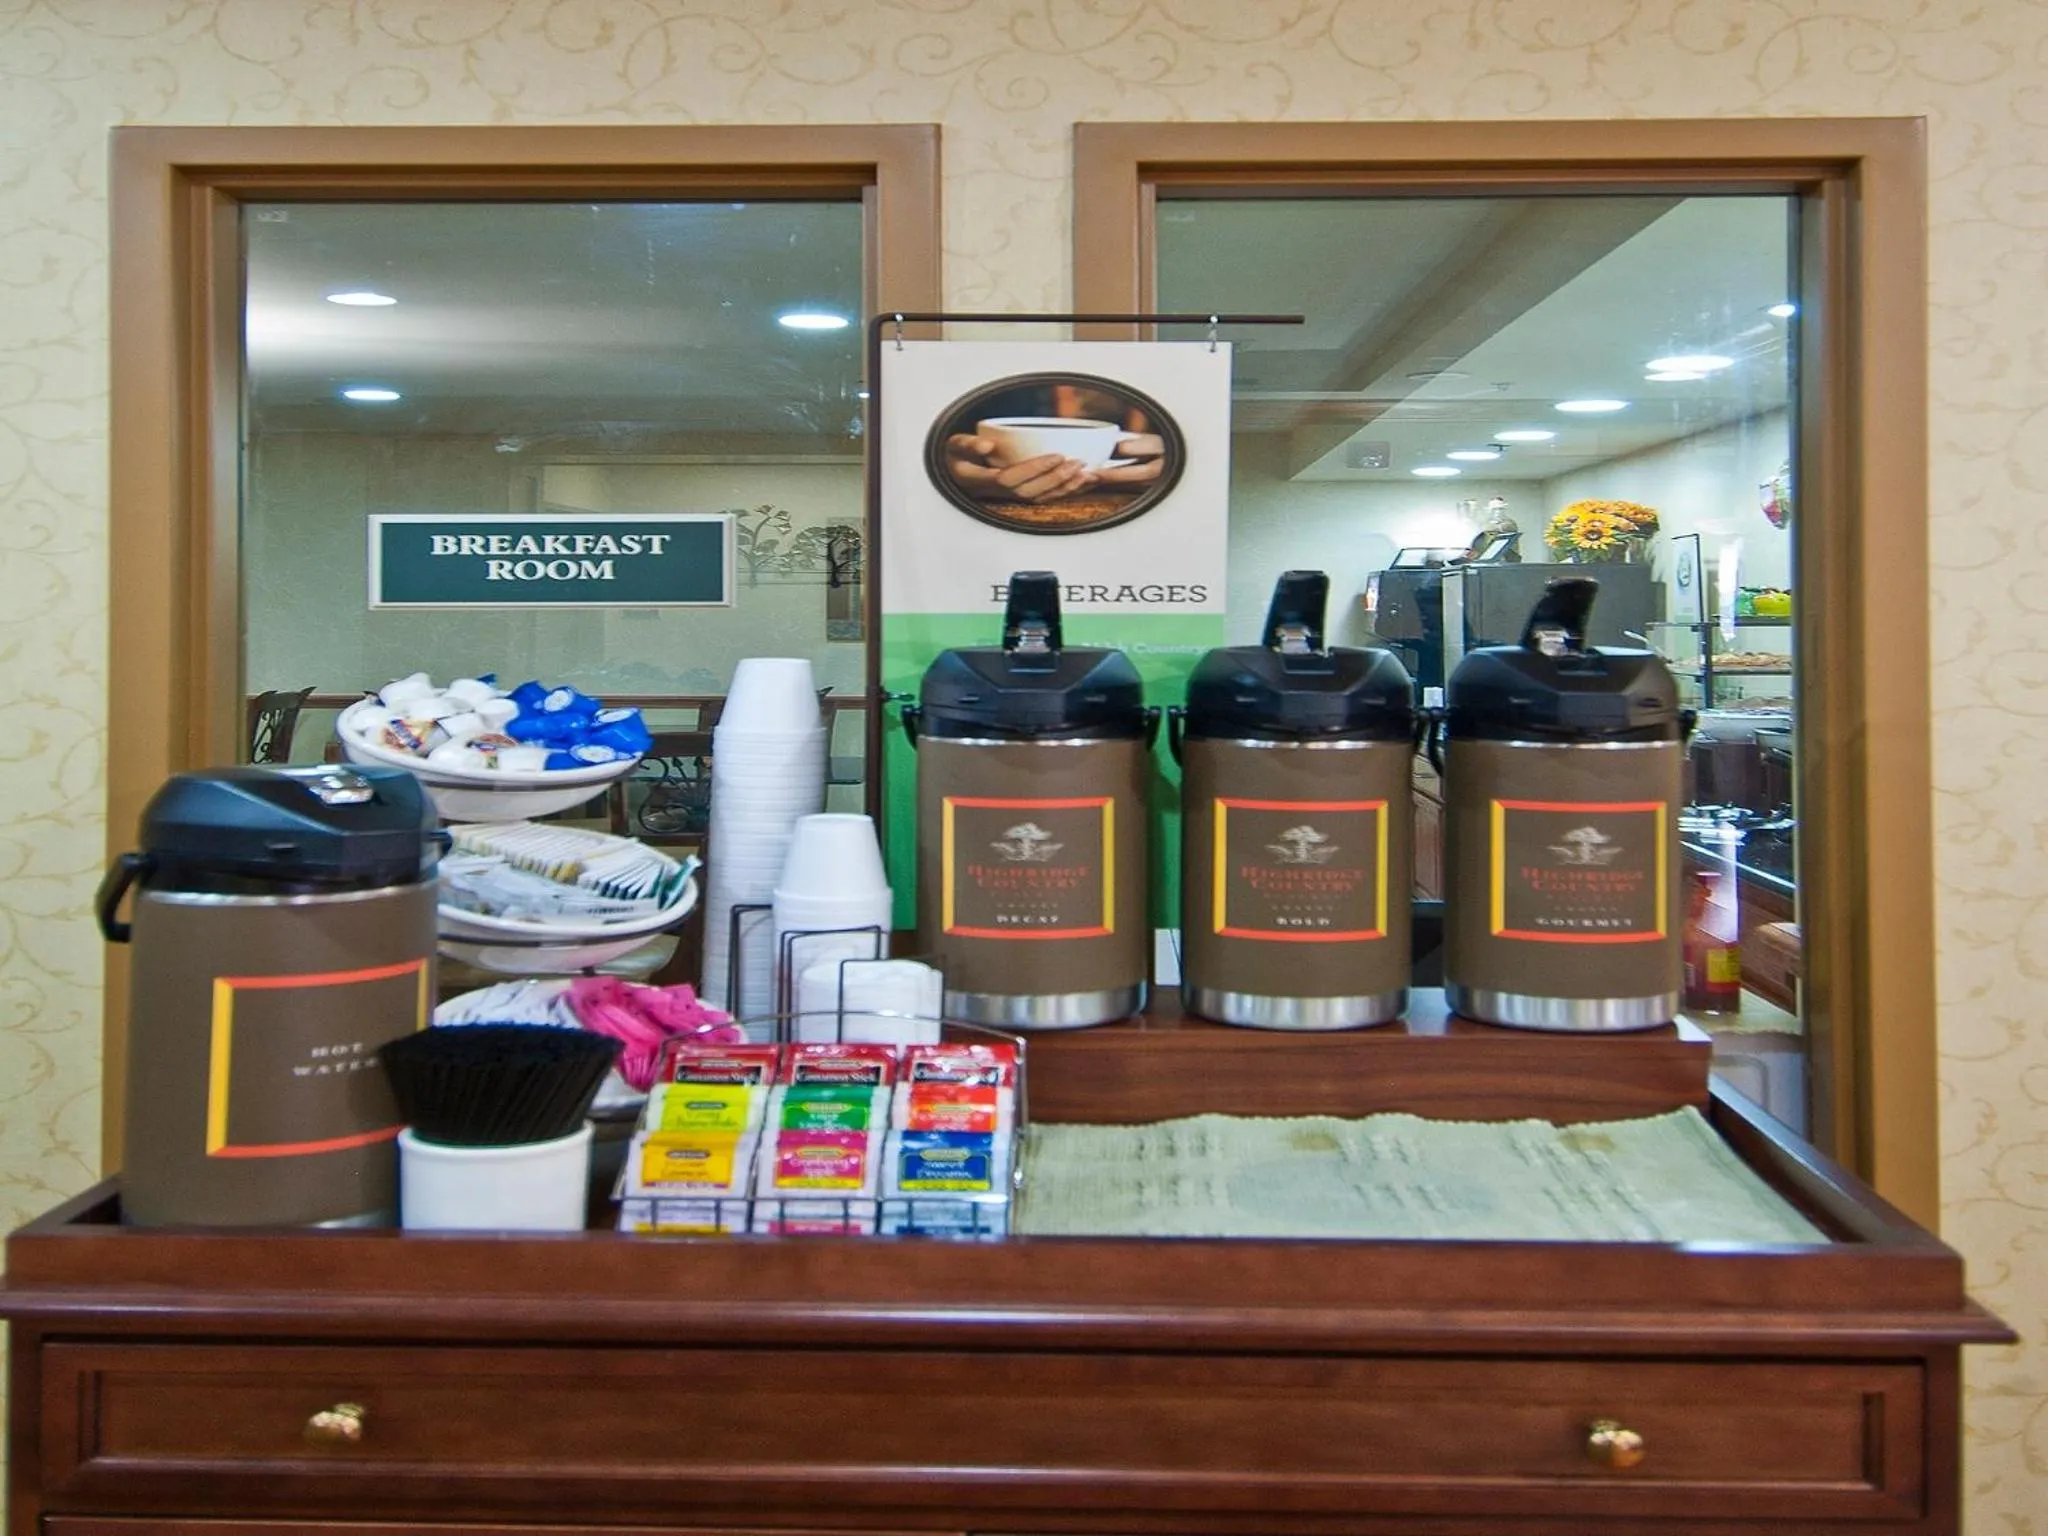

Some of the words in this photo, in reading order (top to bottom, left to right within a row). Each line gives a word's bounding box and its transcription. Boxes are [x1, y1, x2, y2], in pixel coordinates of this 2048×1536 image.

[430, 534, 670, 555] BREAKFAST
[486, 559, 615, 580] ROOM
[990, 585, 1208, 602] BERAGES
[1275, 916, 1332, 926] BOLD
[311, 1043, 362, 1057] HOT
